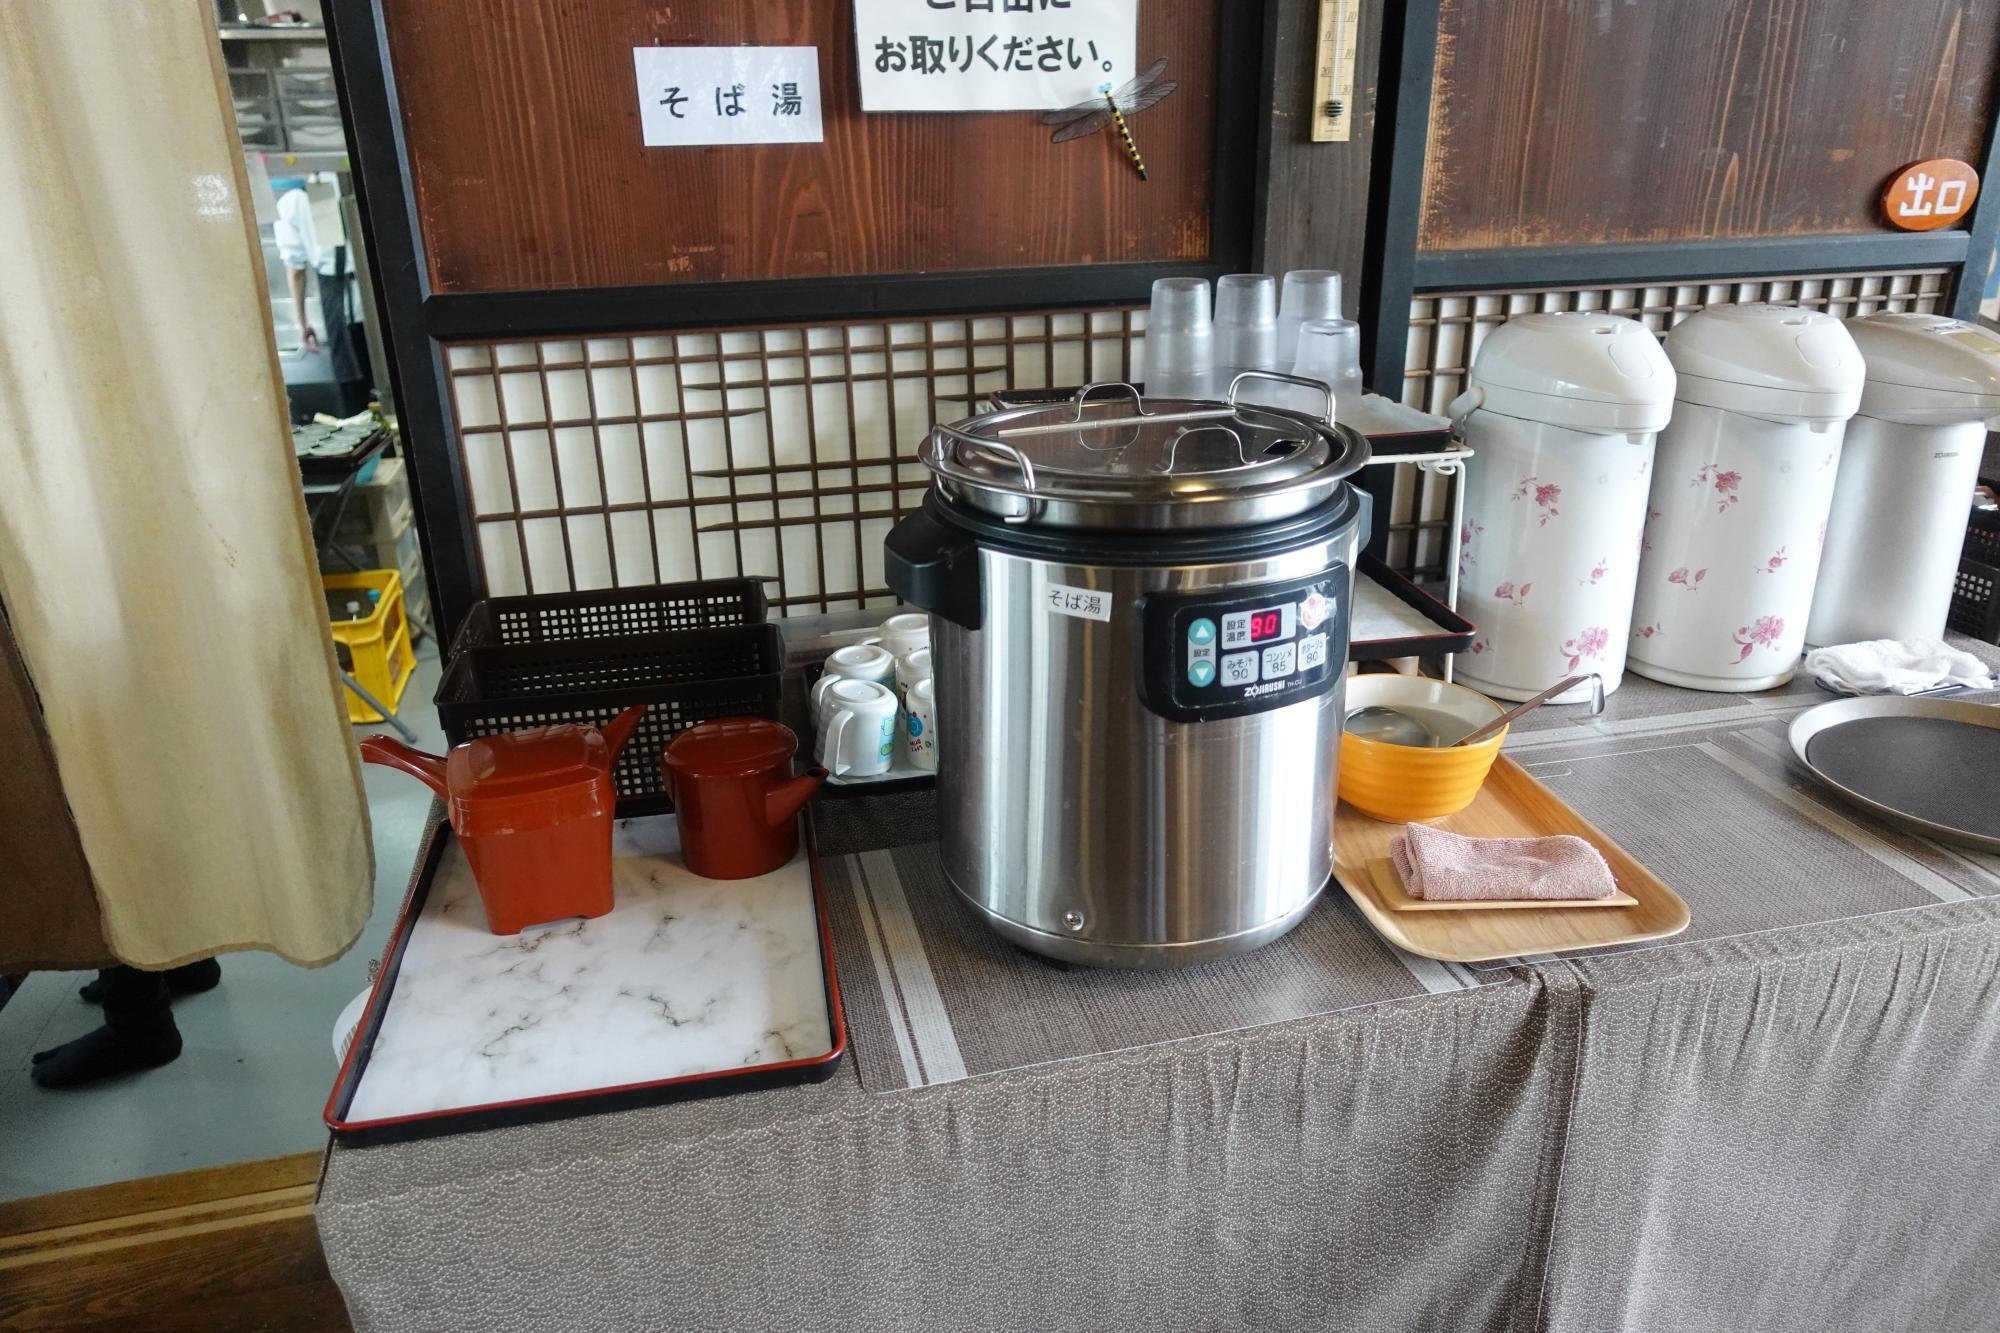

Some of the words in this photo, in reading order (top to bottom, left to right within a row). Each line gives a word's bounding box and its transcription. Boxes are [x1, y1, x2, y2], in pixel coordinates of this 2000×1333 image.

[875, 34, 1112, 74] お取りください。
[659, 82, 802, 119] そば湯
[1900, 173, 1966, 216] 出口
[1048, 590, 1101, 614] そば湯
[1251, 614, 1277, 638] 90
[1272, 661, 1286, 673] 85
[1306, 650, 1318, 663] 80
[1232, 668, 1249, 680] 90
[1244, 680, 1285, 698] ZOJIRUSHI
